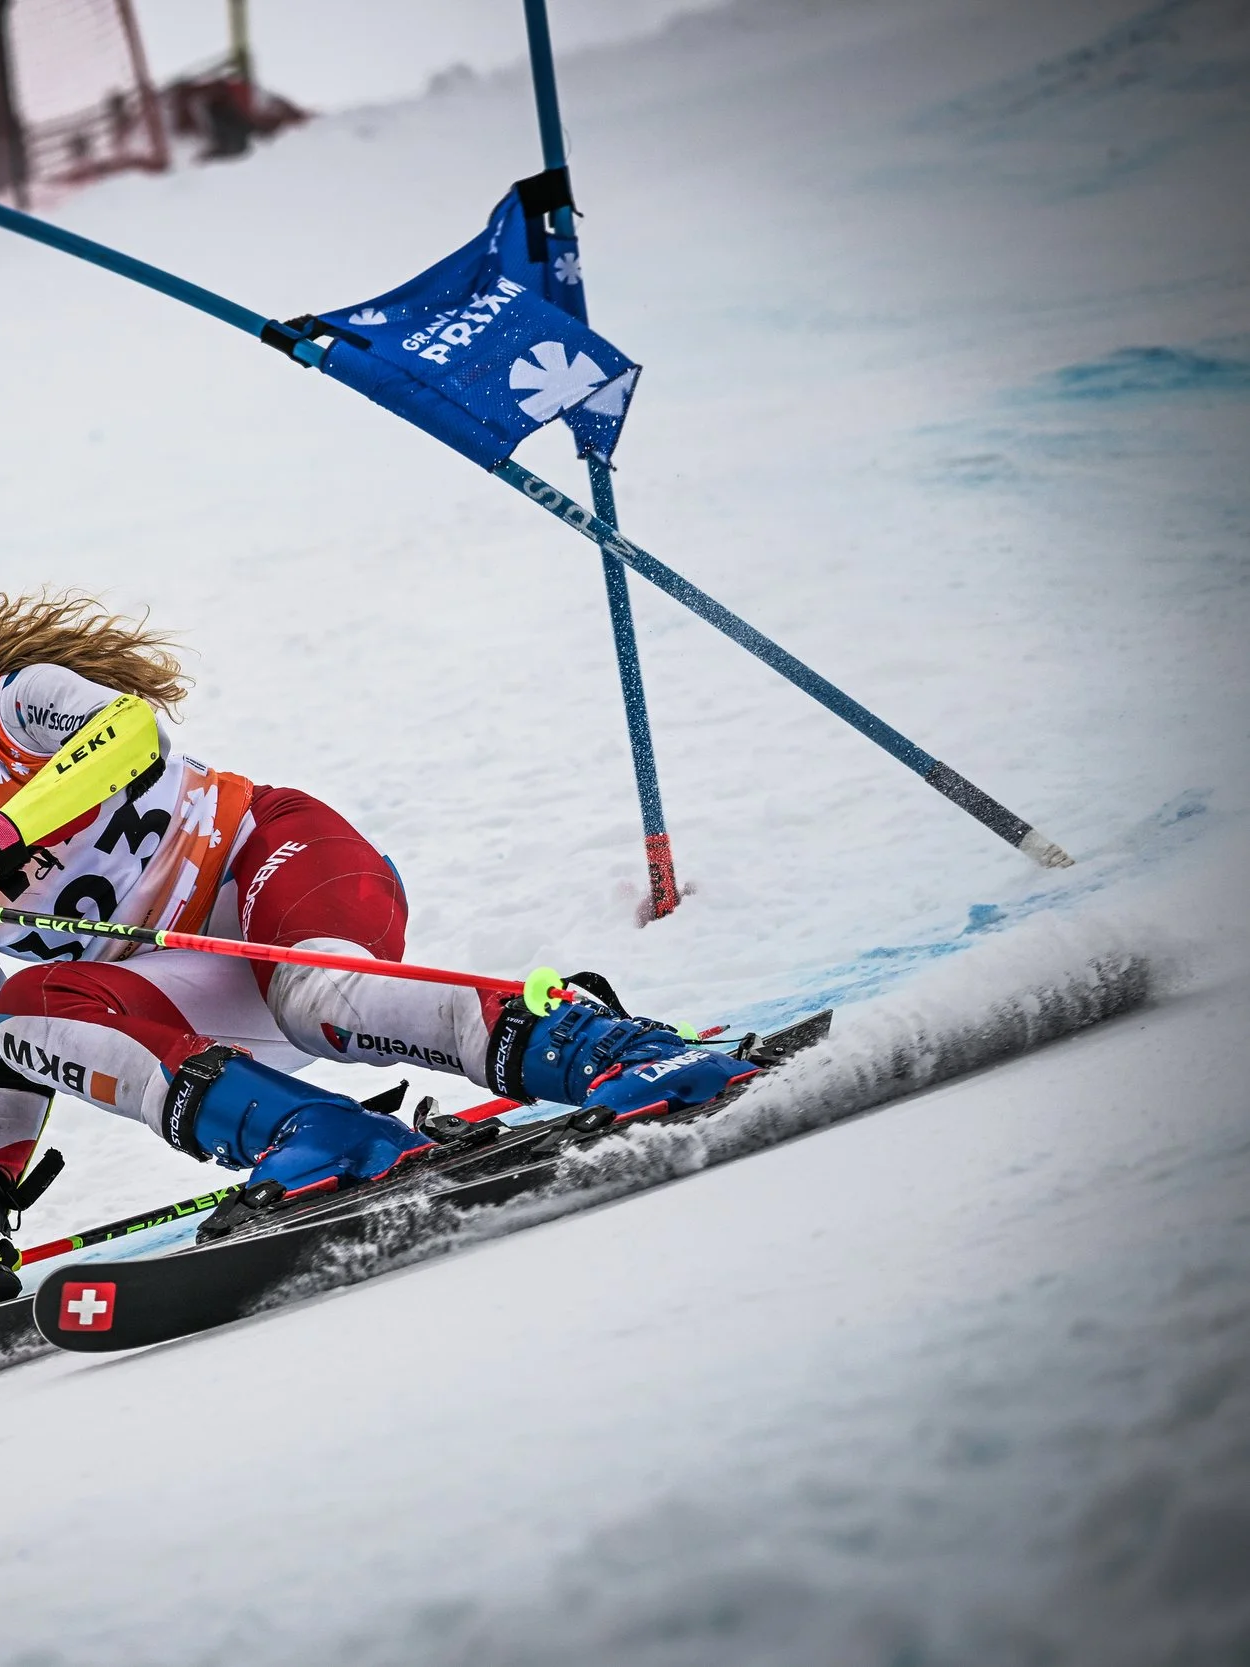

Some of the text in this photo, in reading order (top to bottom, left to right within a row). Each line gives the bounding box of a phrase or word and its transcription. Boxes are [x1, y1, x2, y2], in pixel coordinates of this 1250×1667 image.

[55, 725, 117, 775] LEKI
[3, 1031, 87, 1095] BKW
[357, 1032, 464, 1073] helvetia
[494, 1026, 513, 1094] STÖCKLI
[639, 1050, 711, 1083] LANGE
[169, 1080, 192, 1147] STÖCKLI
